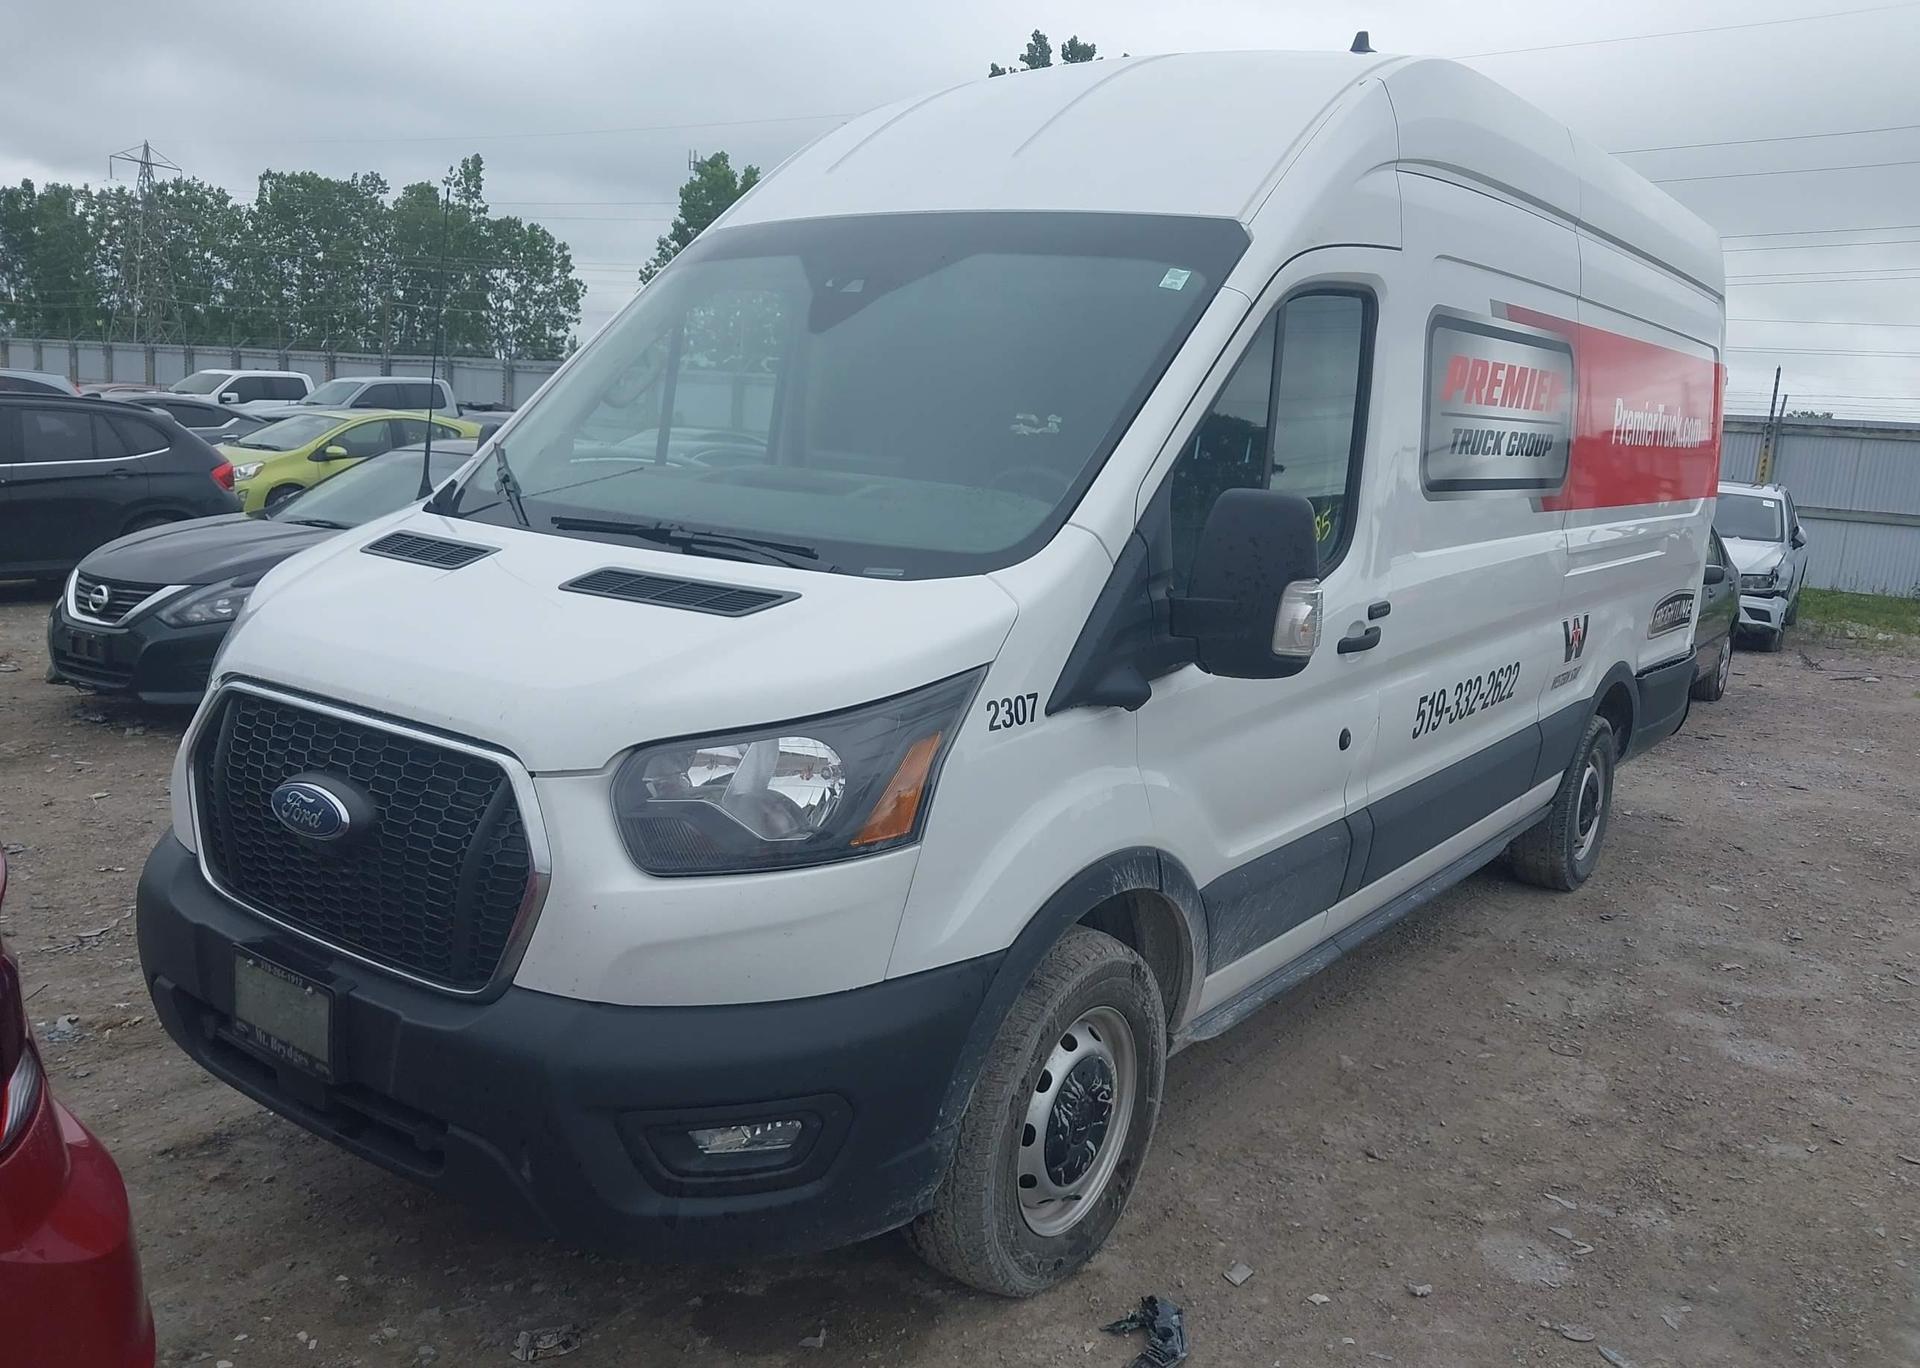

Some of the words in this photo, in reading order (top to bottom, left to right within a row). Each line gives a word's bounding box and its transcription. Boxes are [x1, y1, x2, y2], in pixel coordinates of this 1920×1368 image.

[1441, 356, 1564, 412] PREMIER
[1449, 428, 1506, 456] TRUCK
[1506, 431, 1554, 457] GROUP
[1611, 397, 1702, 449] PremierTruck.com
[986, 692, 1038, 731] 2307
[1412, 661, 1520, 739] 519-332-2622
[282, 791, 324, 828] Ford
